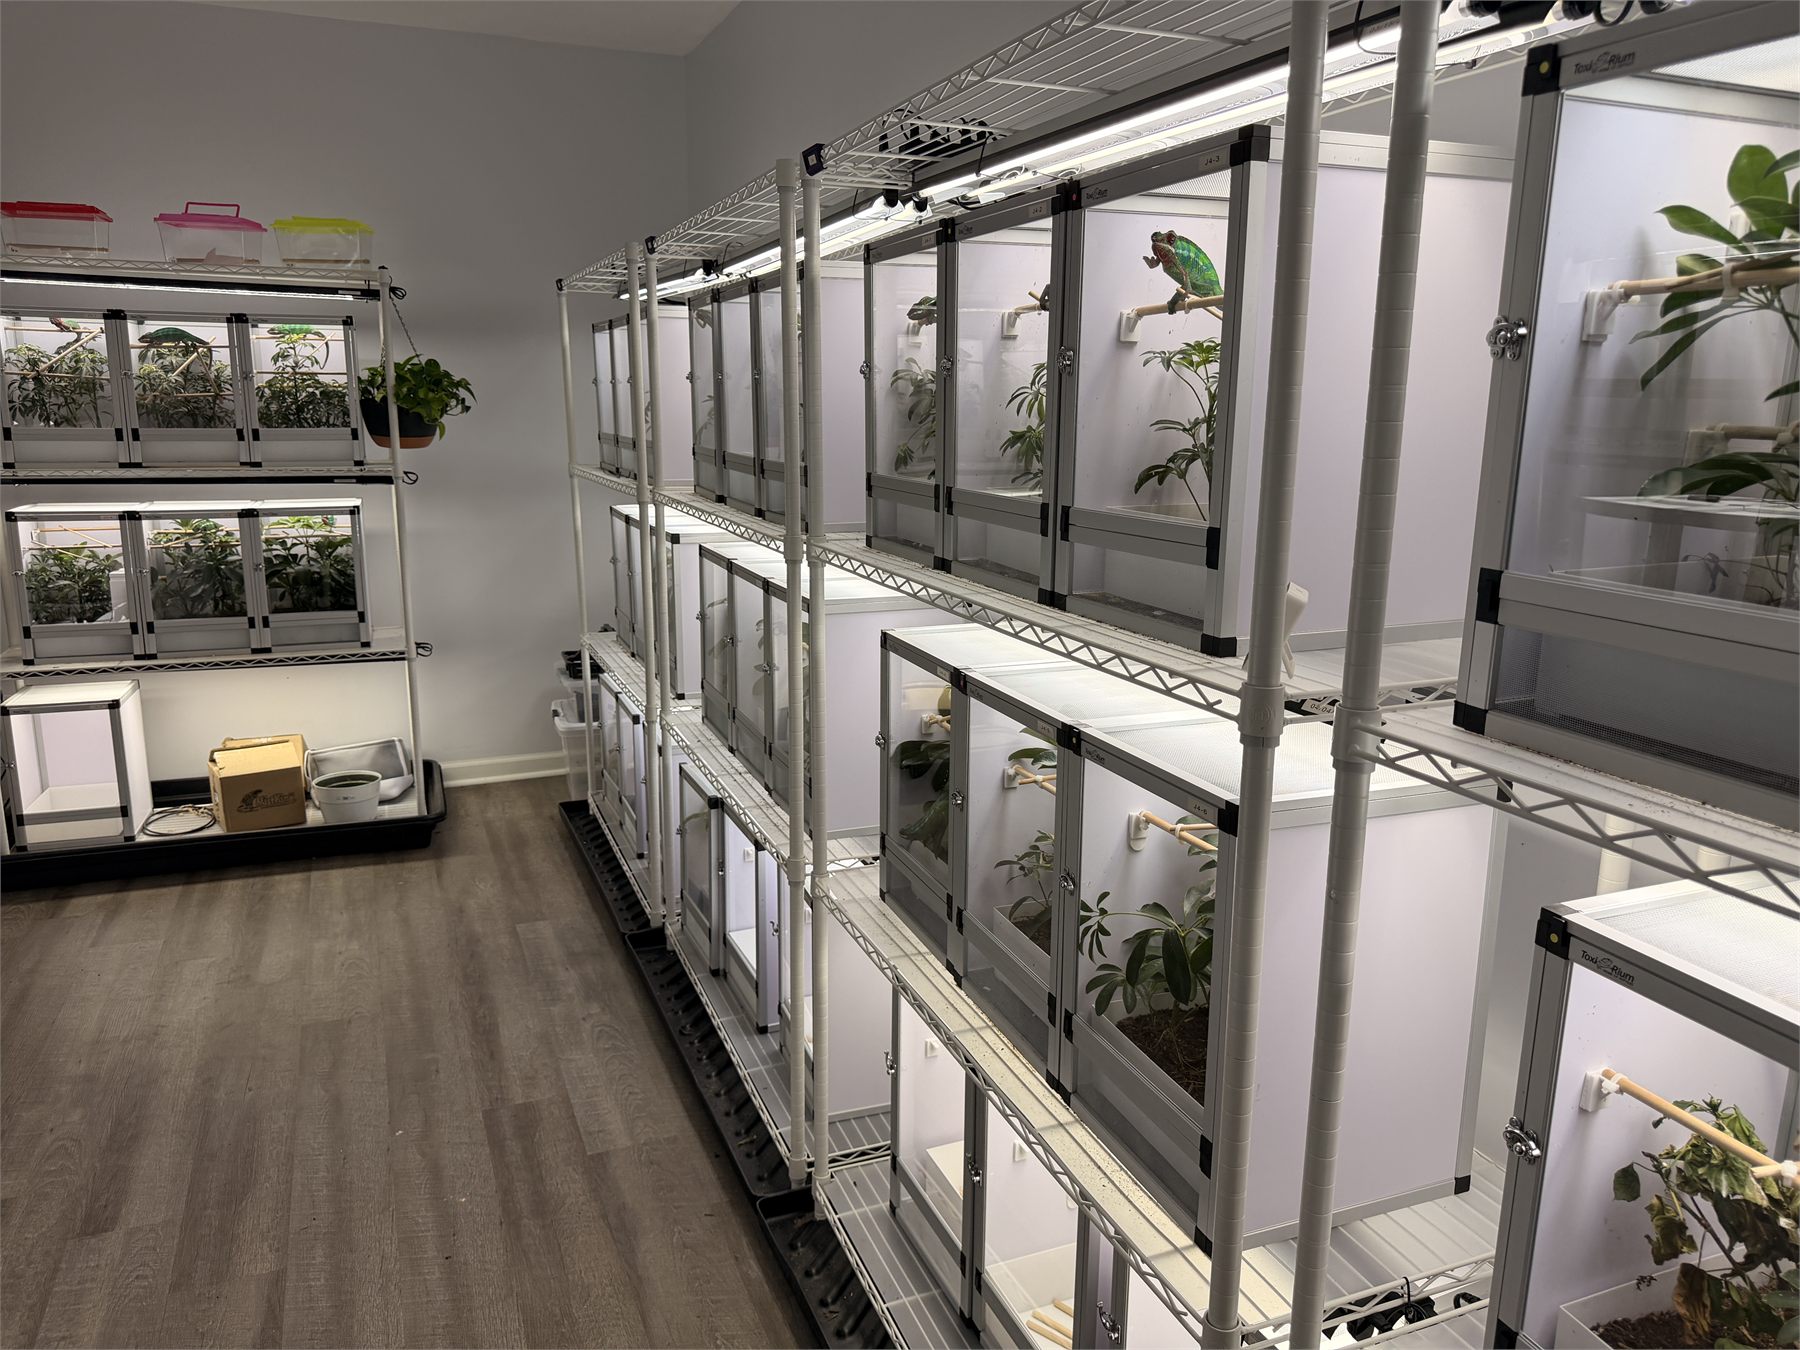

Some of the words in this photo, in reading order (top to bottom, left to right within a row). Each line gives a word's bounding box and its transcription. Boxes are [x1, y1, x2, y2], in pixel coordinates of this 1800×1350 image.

[1574, 60, 1593, 75] Toxi
[1608, 52, 1635, 65] Rium
[1581, 950, 1598, 964] Toxi
[1611, 964, 1635, 983] Rium
